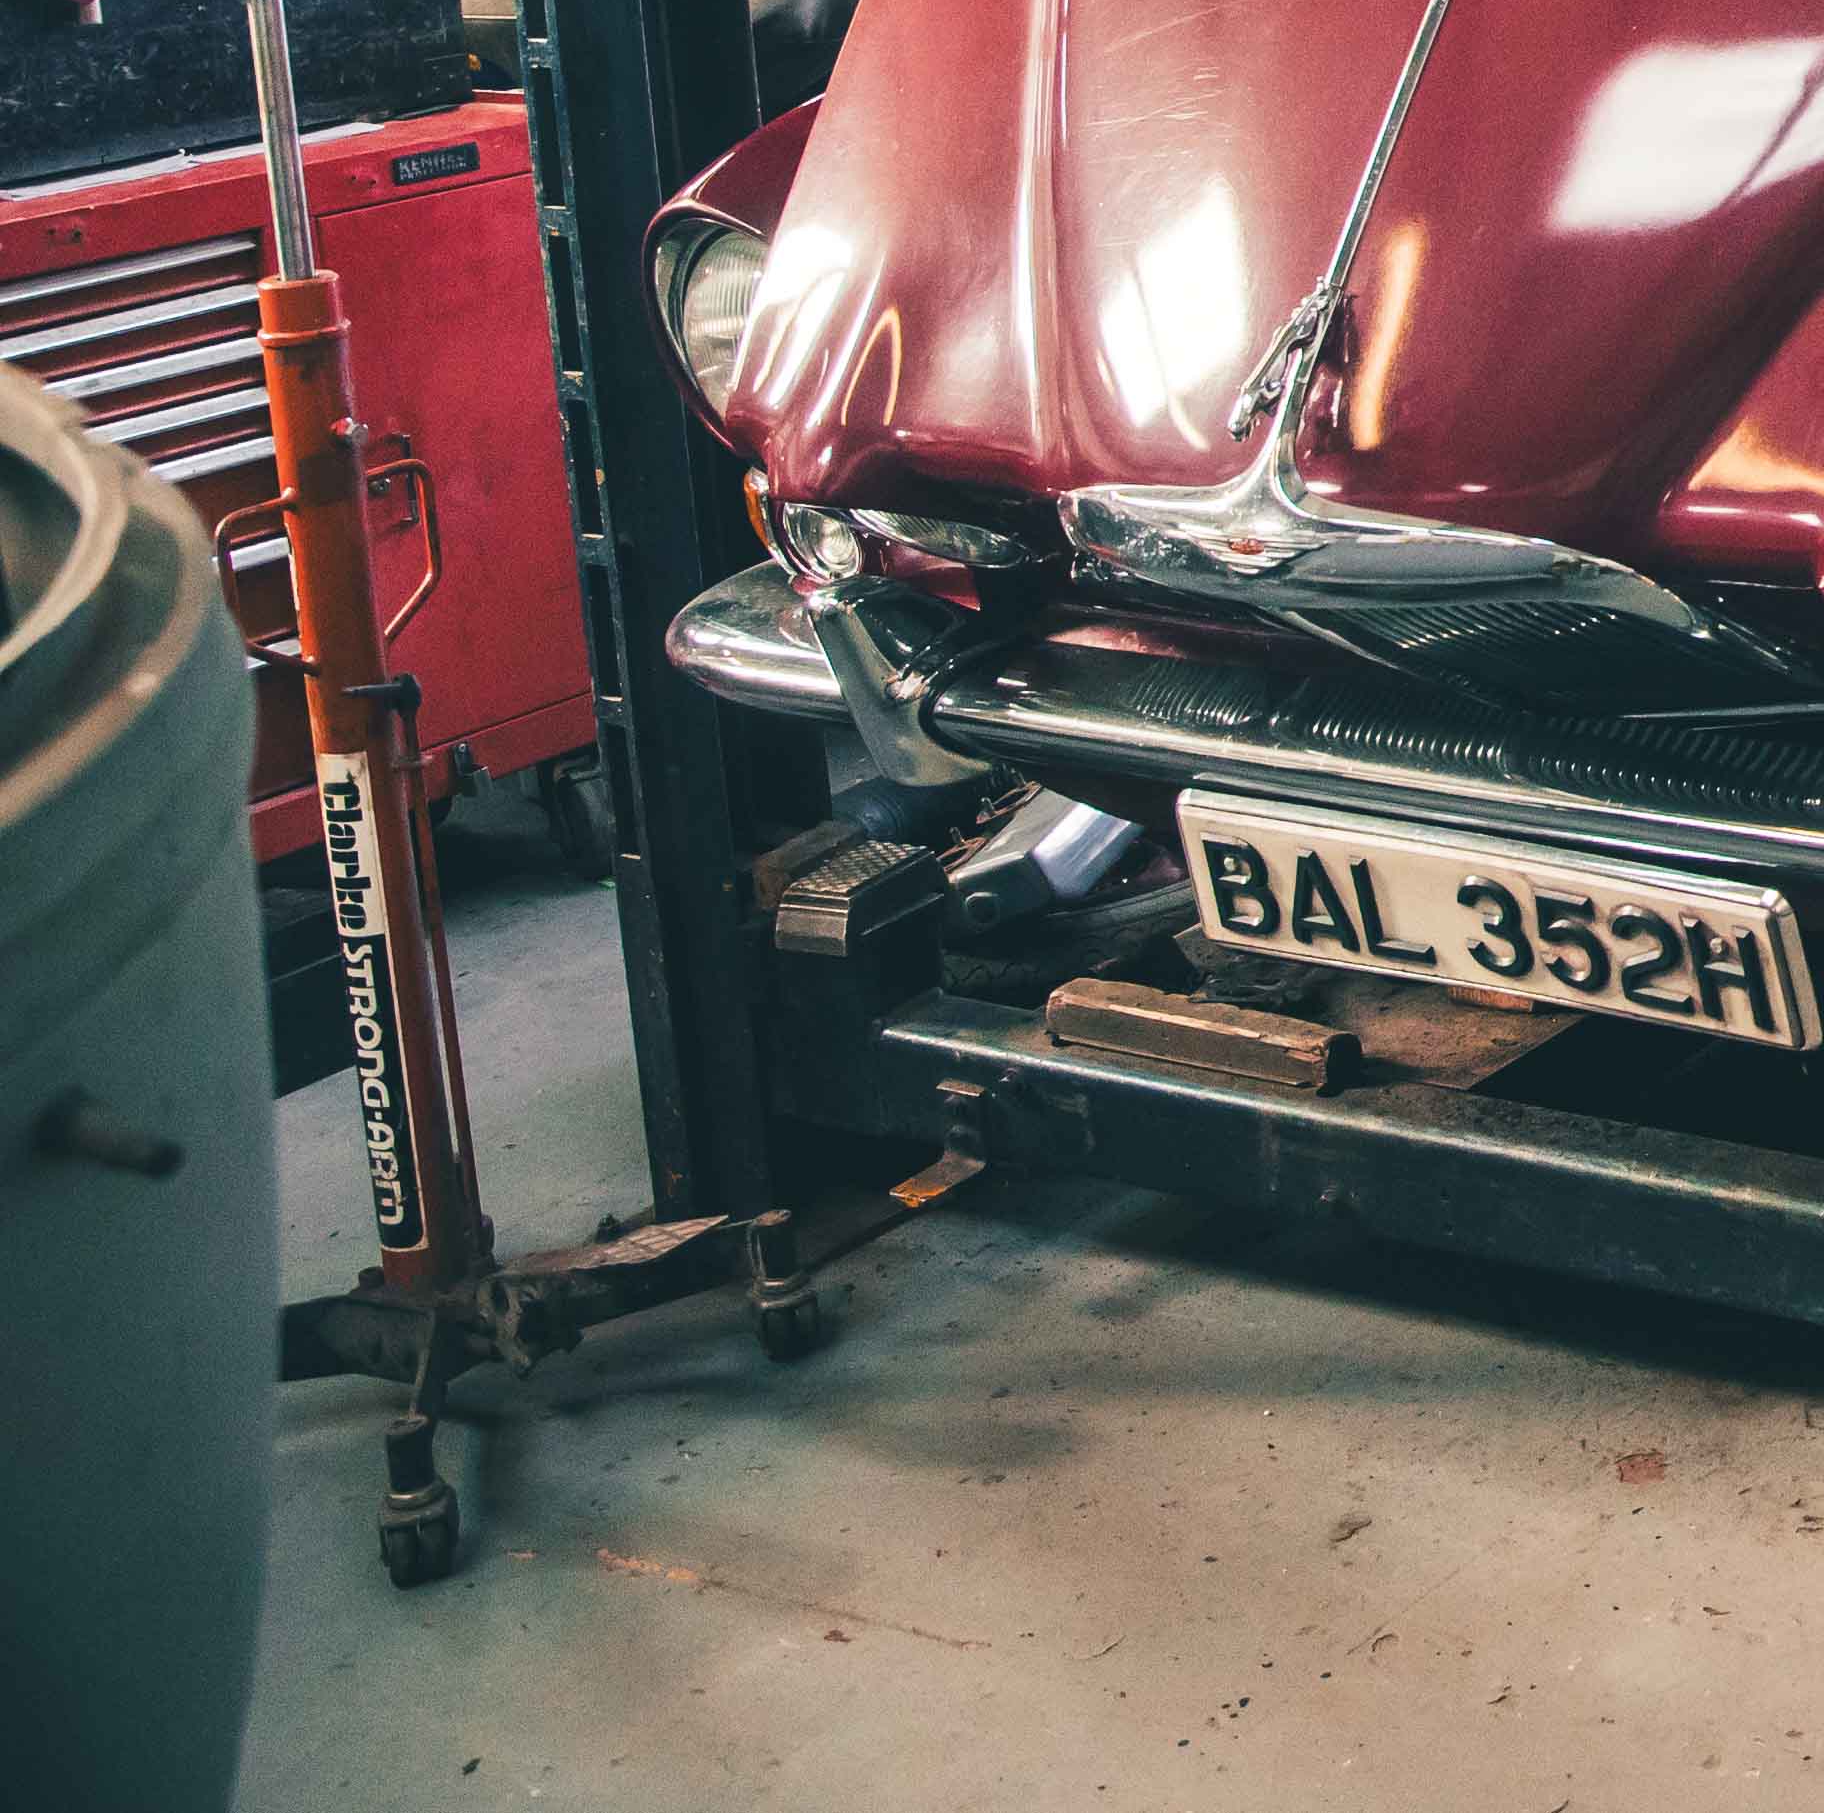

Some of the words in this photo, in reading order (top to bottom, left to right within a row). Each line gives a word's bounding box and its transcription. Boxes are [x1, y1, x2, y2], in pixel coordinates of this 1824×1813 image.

[323, 781, 372, 930] Clarke
[1202, 833, 1437, 965] BAL
[1457, 876, 1777, 1033] 352H
